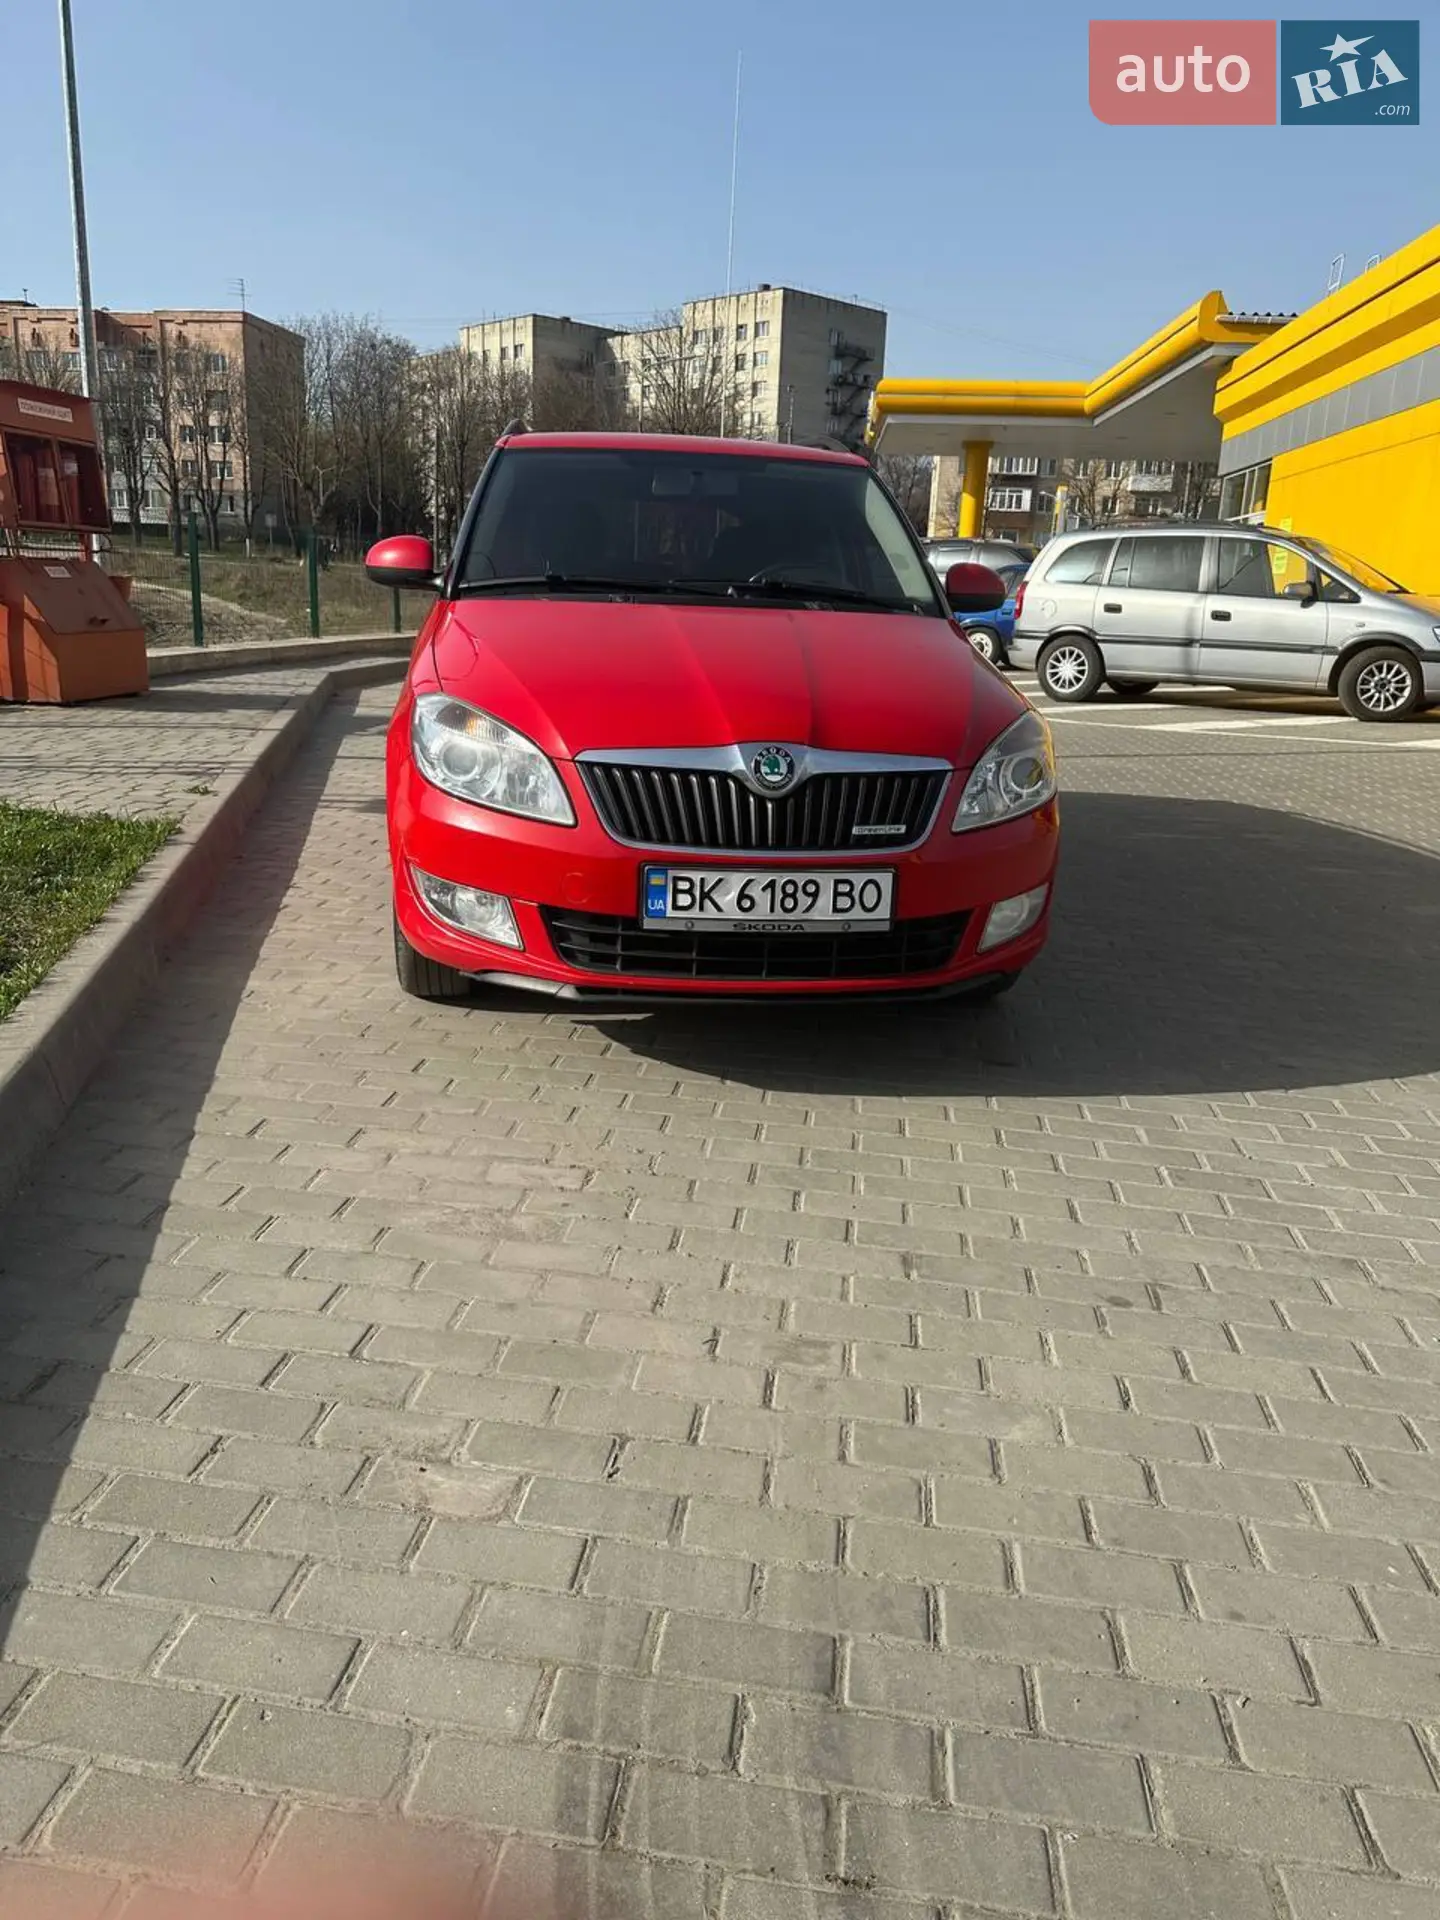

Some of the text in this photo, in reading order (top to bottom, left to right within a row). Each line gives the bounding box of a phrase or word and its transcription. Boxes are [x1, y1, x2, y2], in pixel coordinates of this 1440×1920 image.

[648, 899, 664, 910] UA
[671, 876, 883, 914] BK 6189 BO
